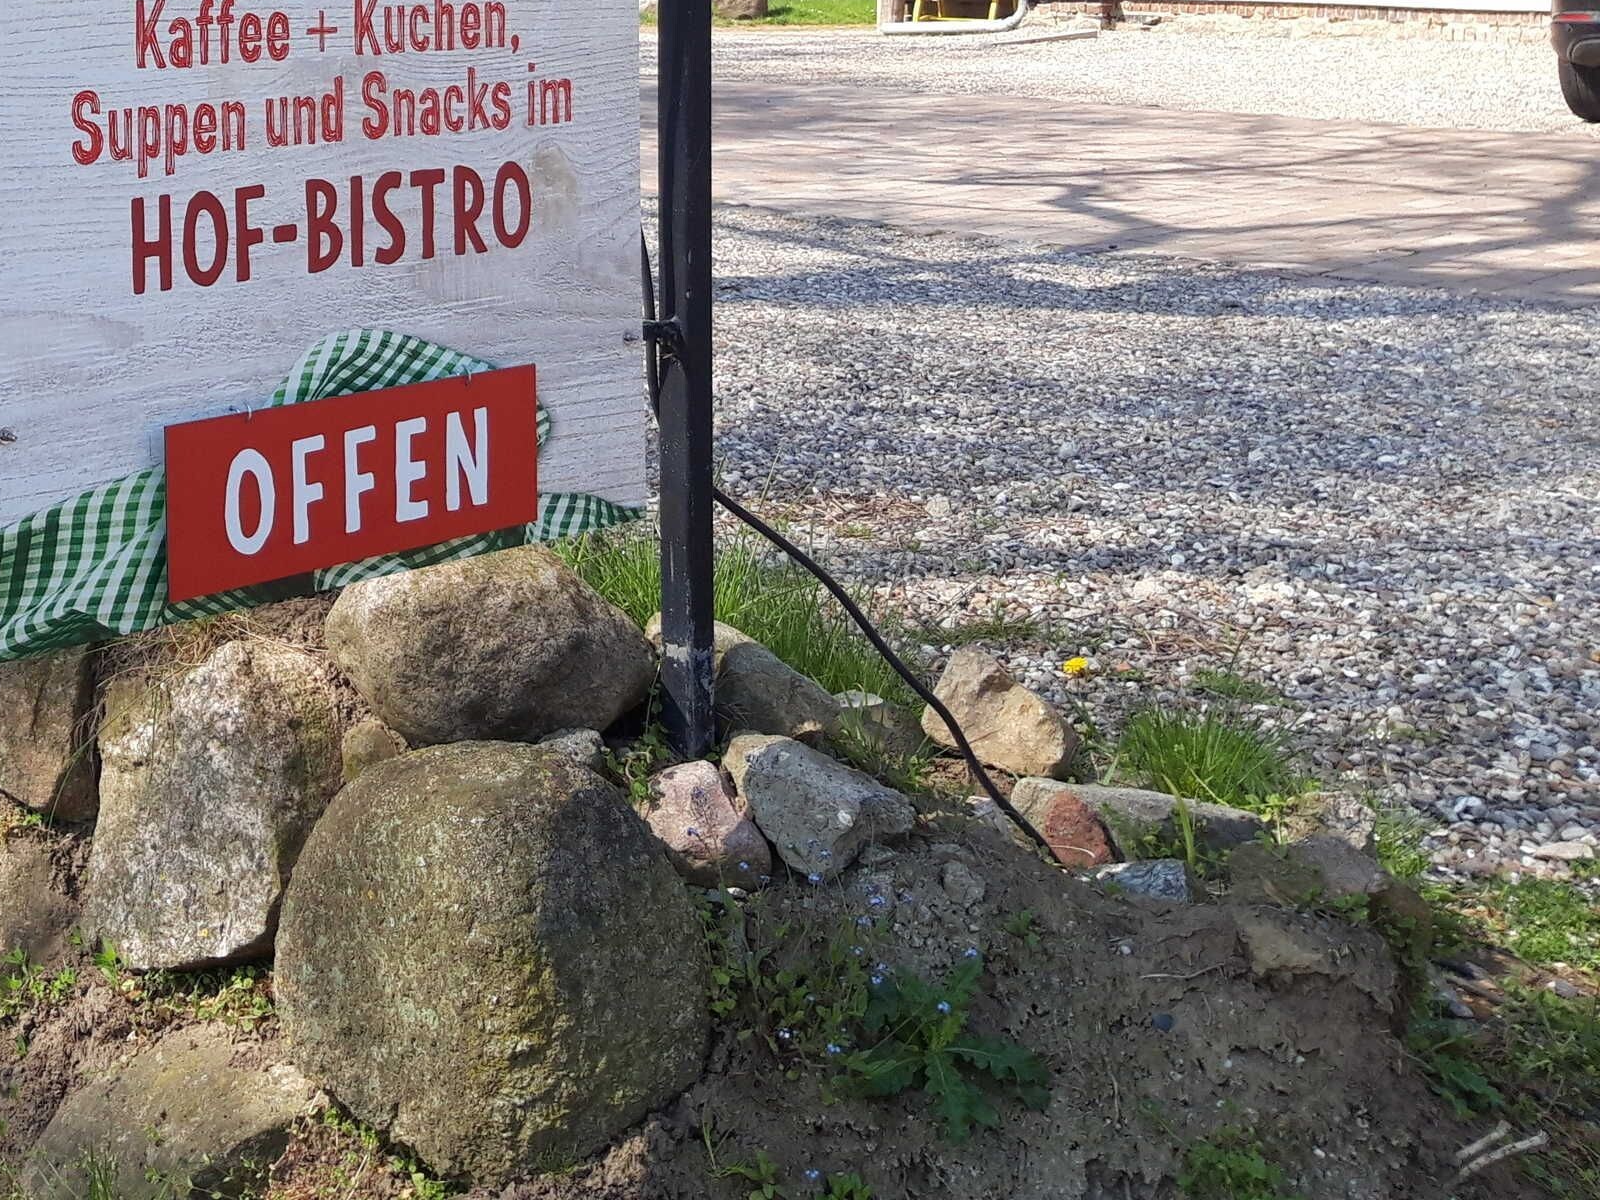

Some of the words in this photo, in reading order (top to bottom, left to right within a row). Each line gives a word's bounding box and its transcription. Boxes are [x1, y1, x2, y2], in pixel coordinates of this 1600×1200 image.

[71, 89, 247, 178] Suppen
[265, 75, 344, 148] und
[361, 66, 512, 141] Snacks
[527, 62, 573, 125] im
[130, 160, 532, 295] HOF-BISTRO
[224, 407, 489, 556] OFFEN
